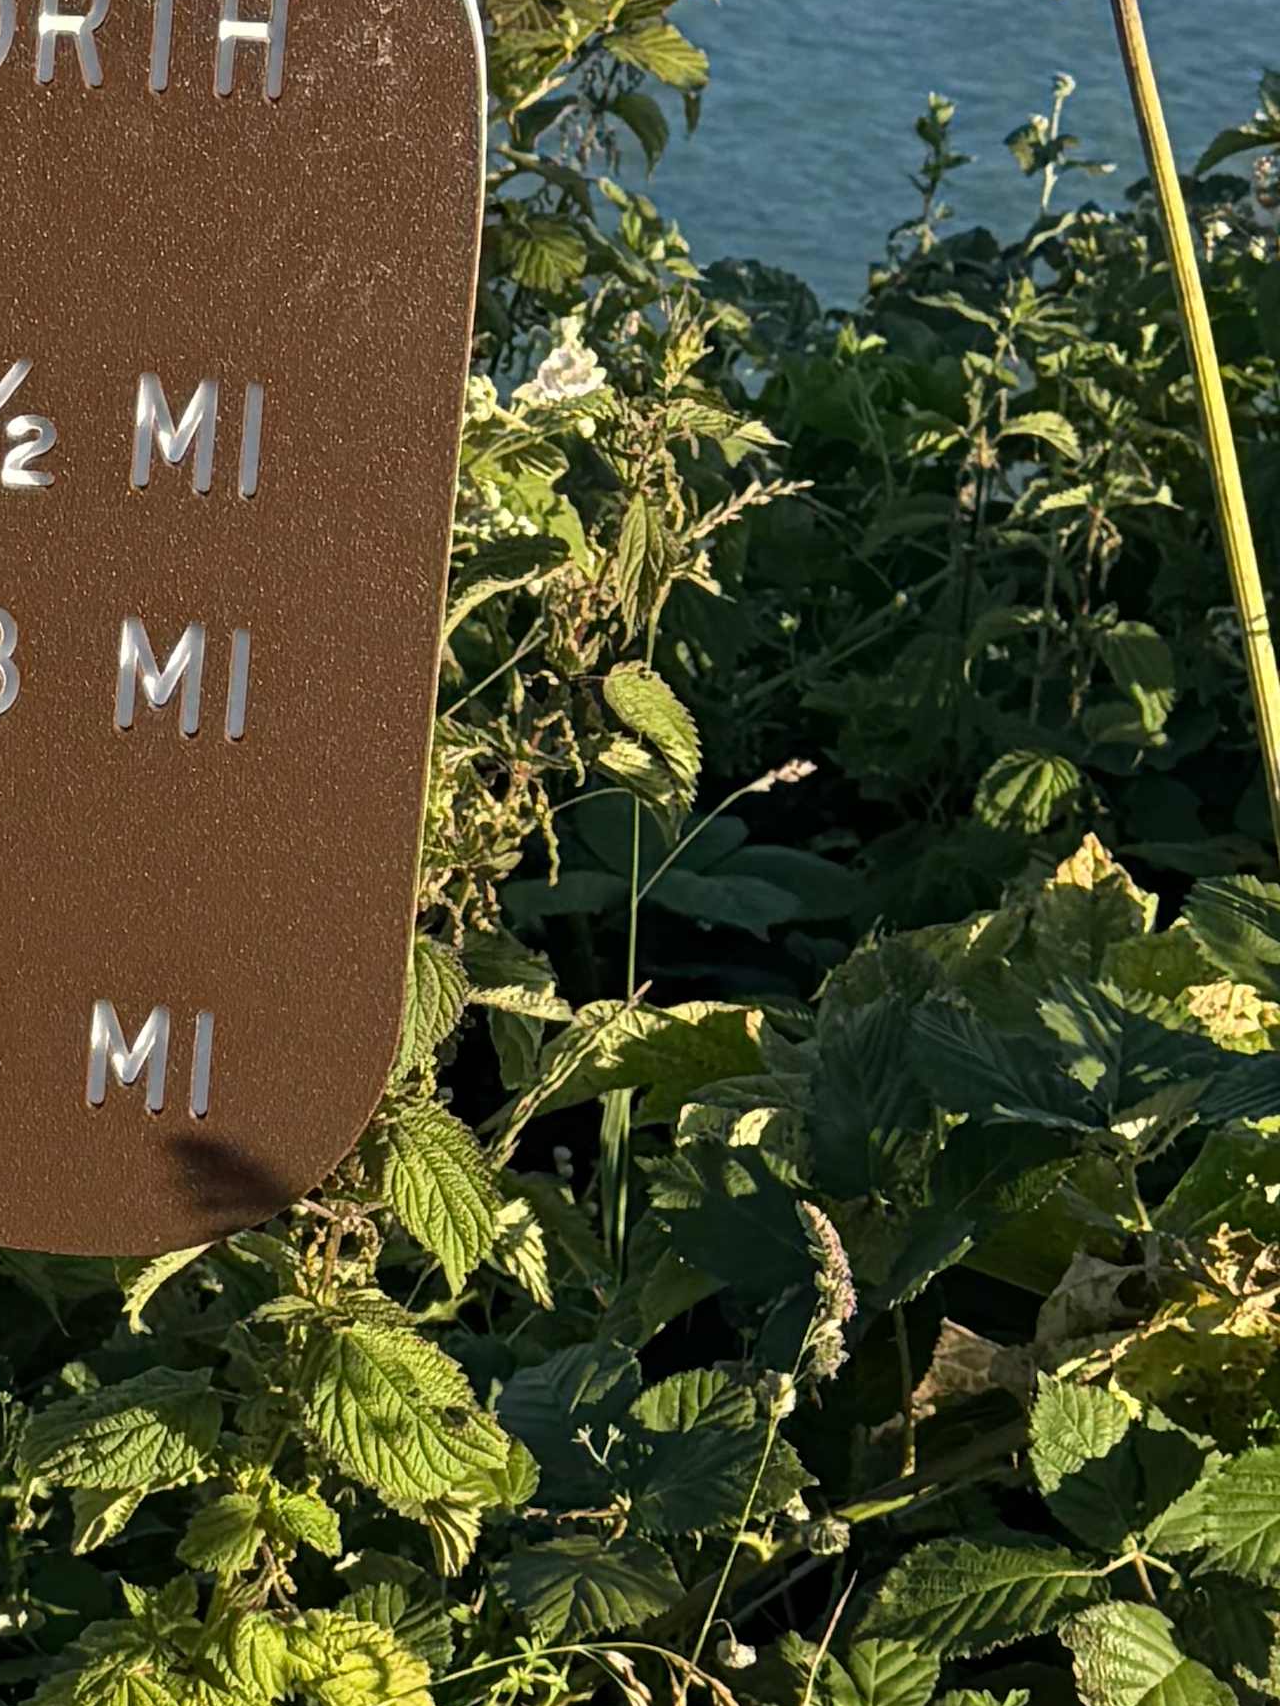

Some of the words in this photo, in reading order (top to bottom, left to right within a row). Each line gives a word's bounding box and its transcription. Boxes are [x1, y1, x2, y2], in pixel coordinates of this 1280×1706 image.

[130, 374, 263, 499] MI
[112, 619, 250, 742] MI
[87, 1001, 213, 1118] MI
